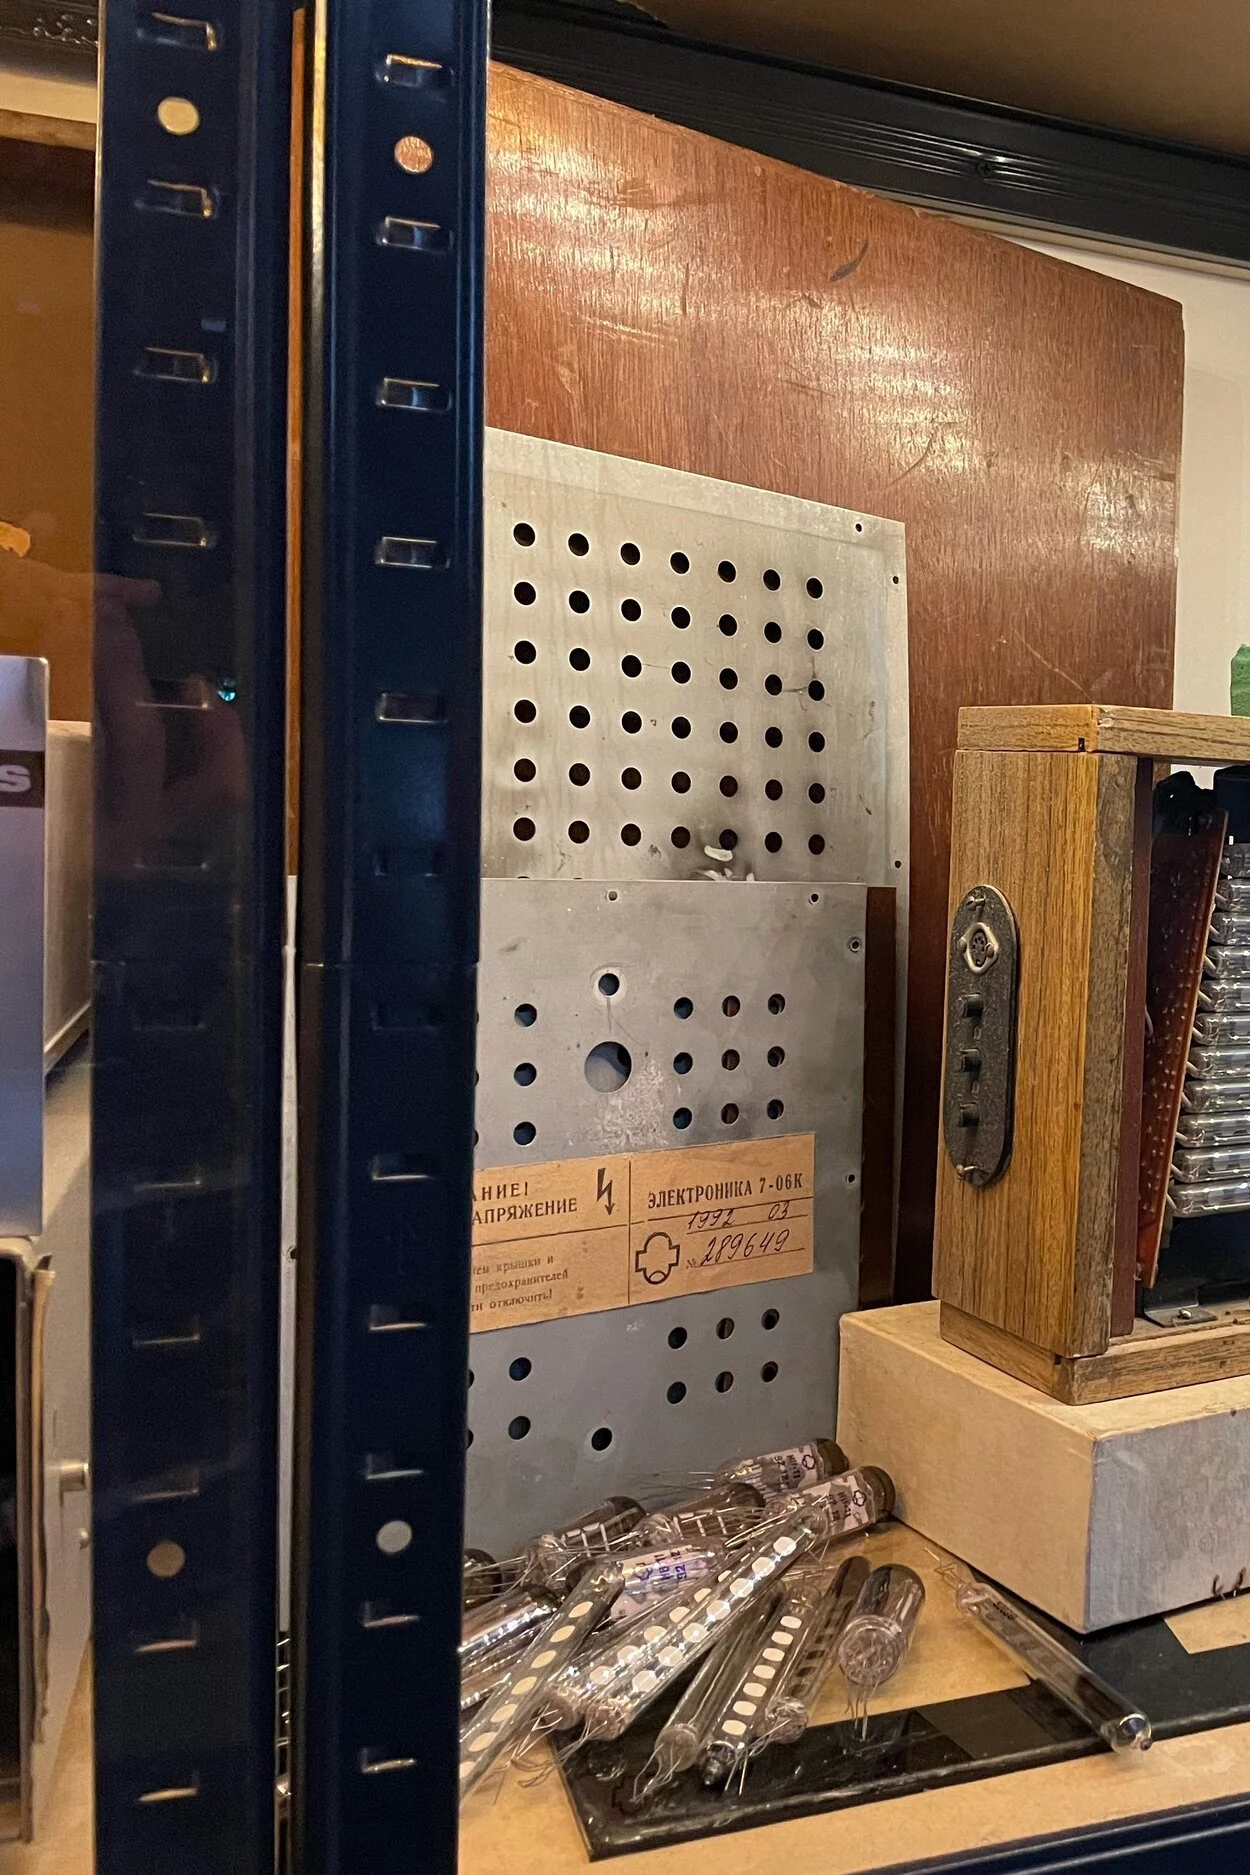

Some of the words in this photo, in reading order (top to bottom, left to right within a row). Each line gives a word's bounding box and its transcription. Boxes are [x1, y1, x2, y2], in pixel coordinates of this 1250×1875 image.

[0, 764, 32, 793] S
[648, 1180, 752, 1209] ЭЛЕКТРОНИКА
[759, 1173, 803, 1194] 7-06К
[472, 1198, 578, 1226] АПРЯЖЕНИЕ
[700, 1228, 790, 1267] 289649
